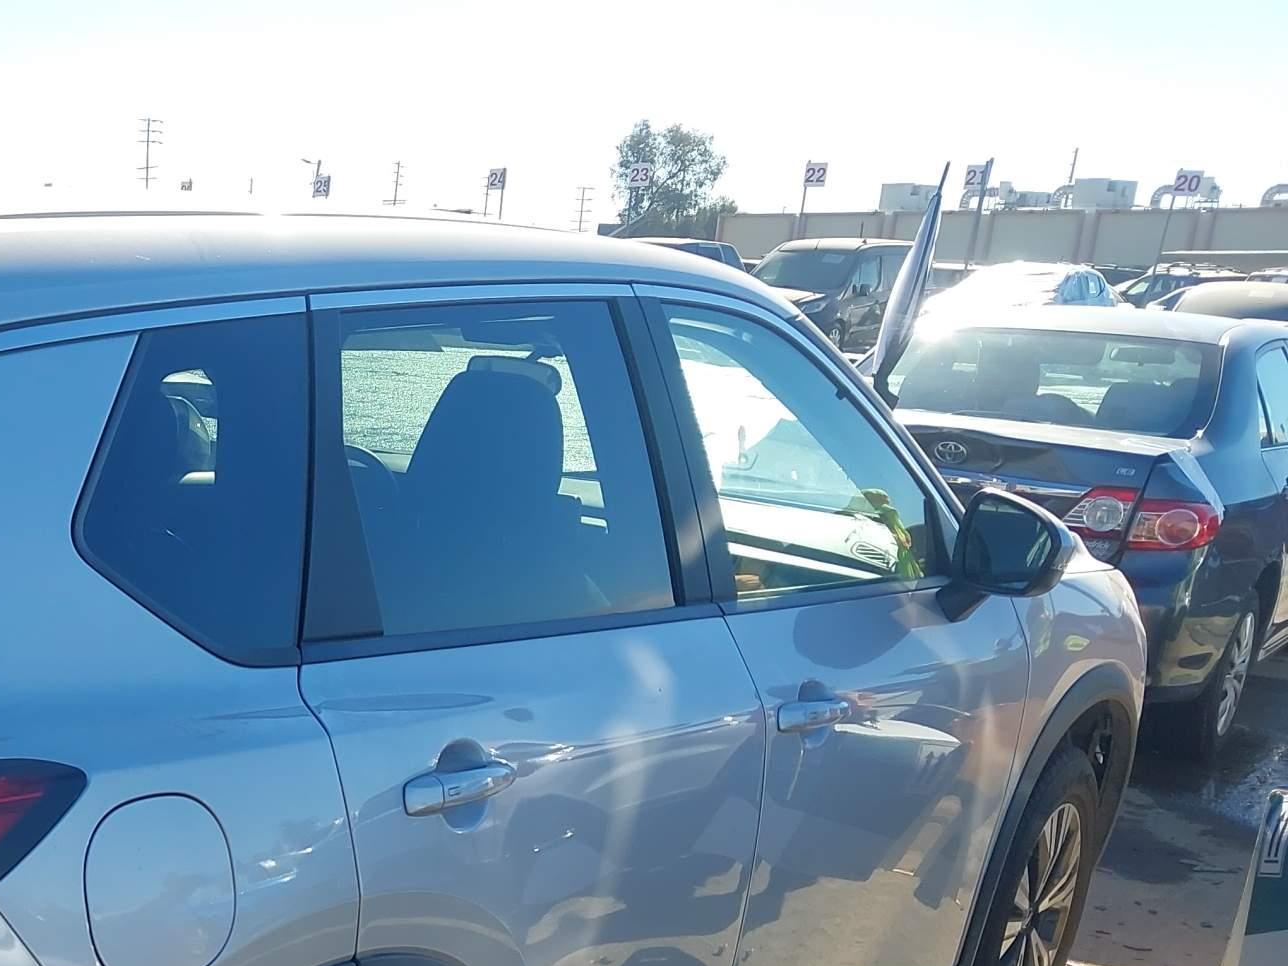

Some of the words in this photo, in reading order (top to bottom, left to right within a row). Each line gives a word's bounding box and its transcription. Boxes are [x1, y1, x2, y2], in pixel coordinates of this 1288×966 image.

[489, 170, 504, 187] 24
[629, 167, 649, 183] 23
[804, 167, 827, 183] 22
[965, 169, 986, 186] 21
[1173, 174, 1201, 192] 20
[315, 179, 329, 194] 25
